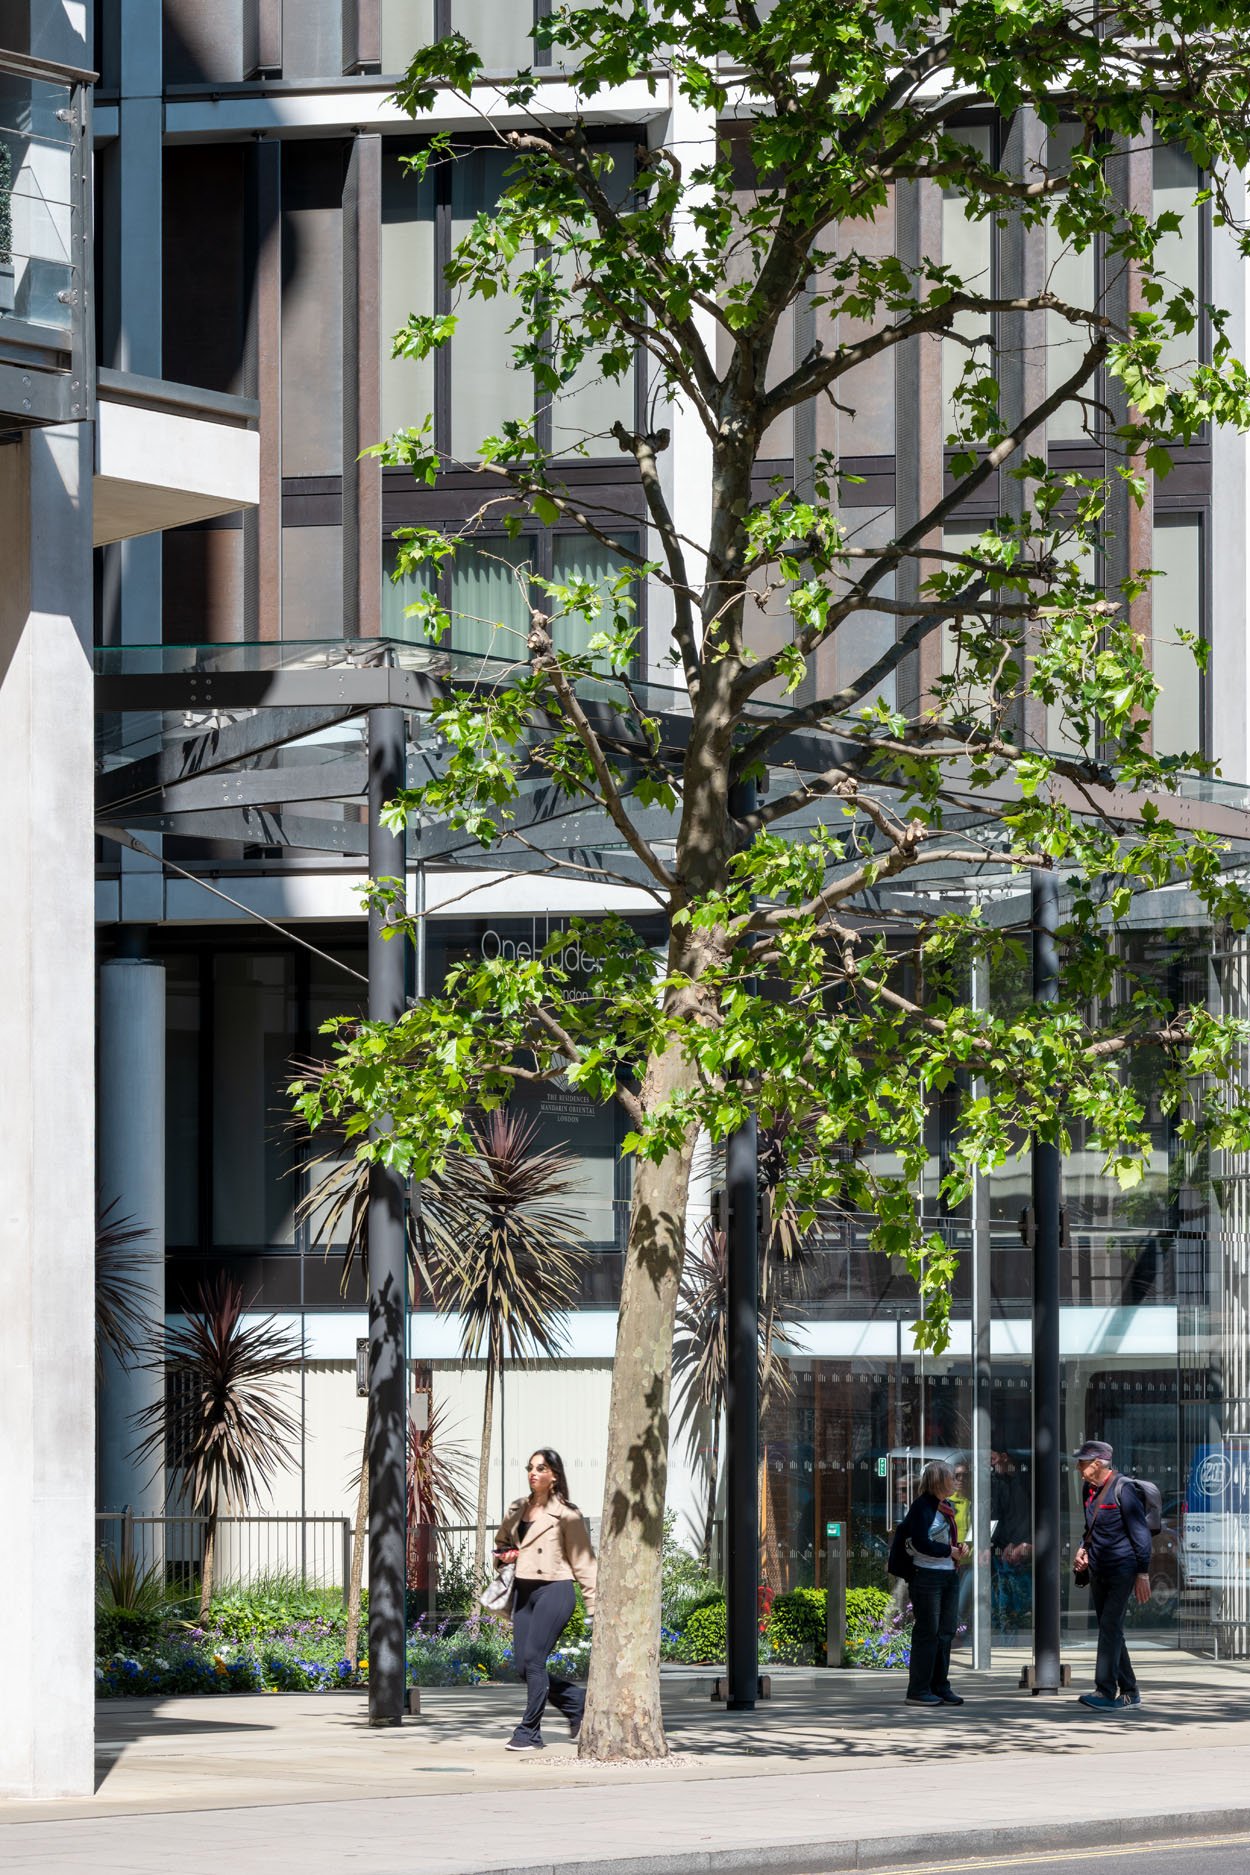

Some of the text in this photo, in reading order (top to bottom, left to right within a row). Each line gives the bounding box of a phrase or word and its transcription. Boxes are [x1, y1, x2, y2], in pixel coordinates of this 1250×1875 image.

[481, 907, 642, 982] OneHyde
[559, 1094, 590, 1103] RESIDENCES
[540, 1103, 596, 1115] MANDARIN ORIENTAL
[557, 1115, 579, 1123] LONDON
